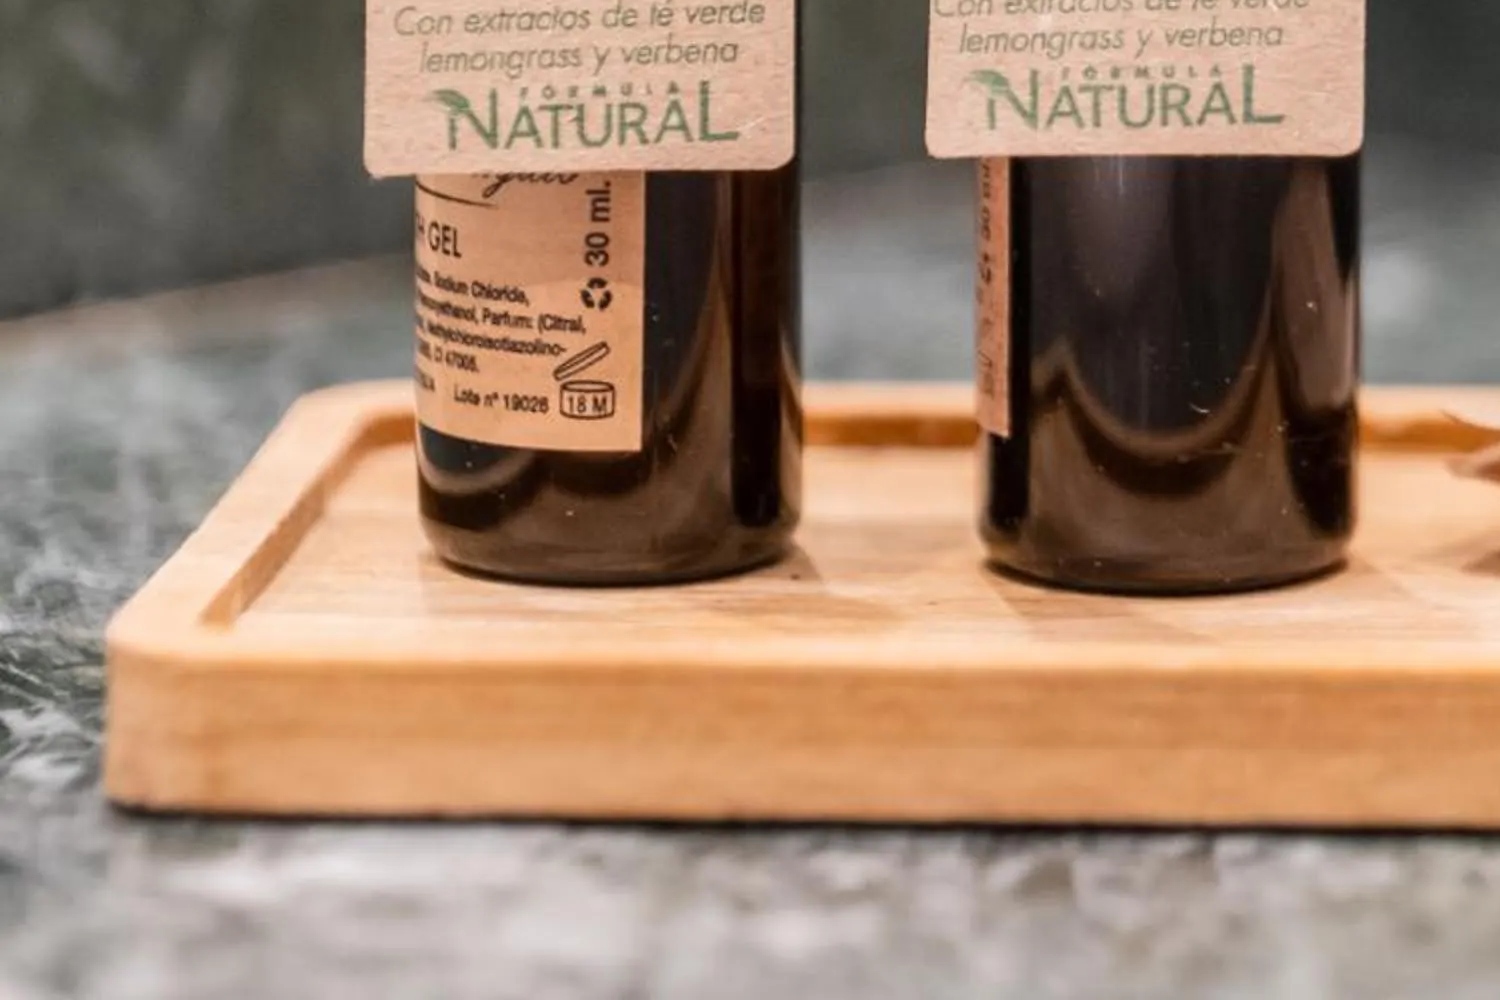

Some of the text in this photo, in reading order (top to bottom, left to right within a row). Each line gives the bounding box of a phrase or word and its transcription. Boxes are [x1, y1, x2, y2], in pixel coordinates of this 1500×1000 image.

[393, 5, 453, 36] Con
[463, 3, 592, 34] extractos
[959, 15, 1285, 61] lemongrass y verbena
[418, 32, 740, 81] lemongrass y verbena
[968, 63, 1286, 132] NATURAL
[432, 80, 740, 152] NATURAL
[428, 220, 463, 259] GEL
[584, 232, 610, 266] 30
[471, 280, 530, 307] Chloride,
[453, 383, 481, 407] Lote
[567, 395, 609, 415] 18 M
